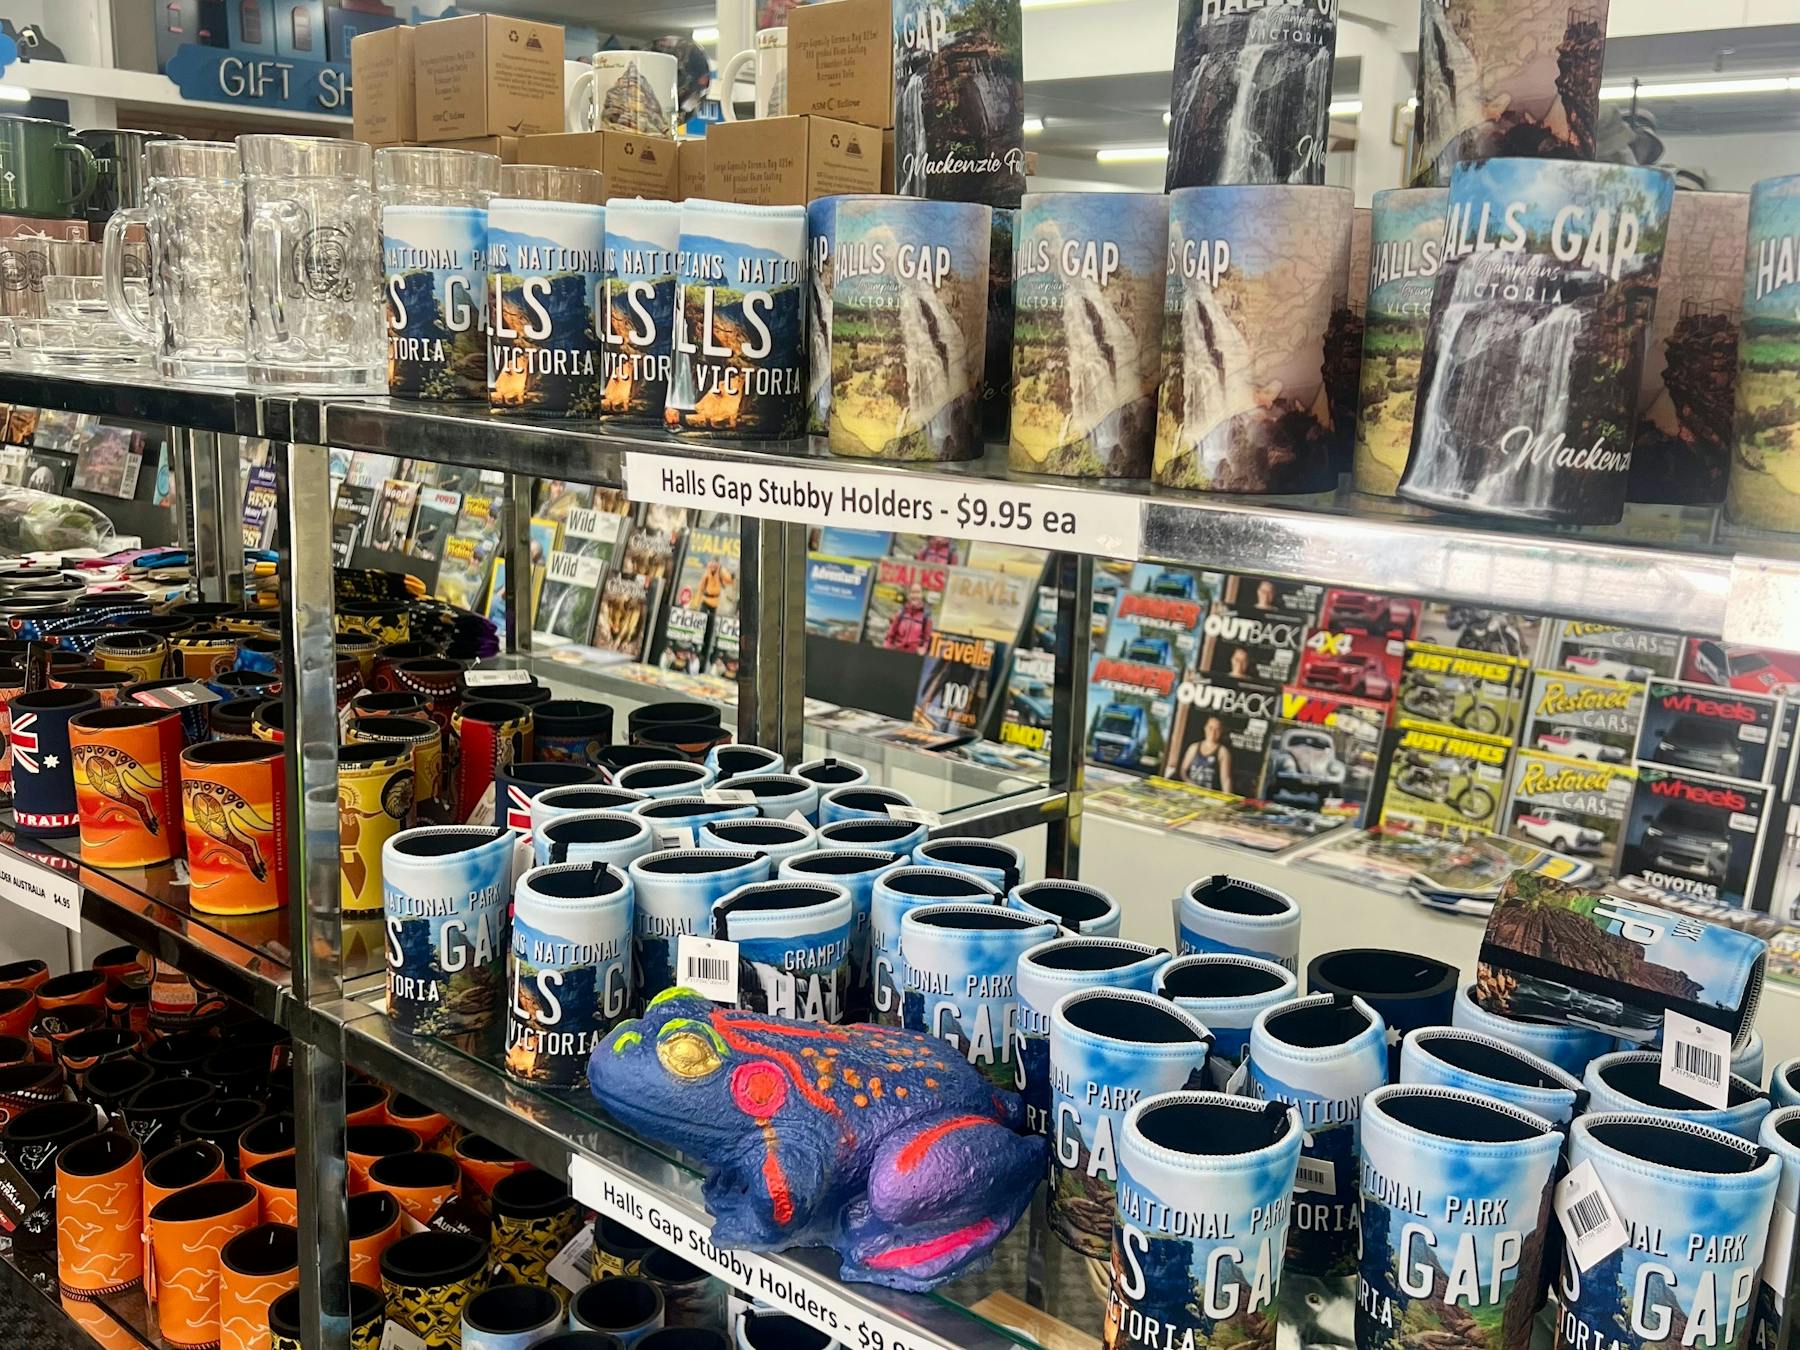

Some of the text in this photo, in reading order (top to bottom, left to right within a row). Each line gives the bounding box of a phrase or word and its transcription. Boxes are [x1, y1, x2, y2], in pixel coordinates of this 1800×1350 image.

[903, 5, 947, 53] GAP
[1249, 29, 1324, 45] VICTORIA
[219, 57, 294, 100] GIFT
[902, 150, 1002, 182] Mackenzie
[518, 245, 602, 272] NATIONA
[1551, 204, 1639, 282] GAP
[834, 242, 950, 289] HALLS GAP
[1062, 240, 1120, 287] GAP
[1183, 239, 1230, 288] GAP
[1370, 240, 1438, 296] HALLS
[1455, 282, 1562, 305] VICTORIA
[674, 283, 774, 359] LLS
[493, 344, 595, 376] VICTORIA
[603, 352, 671, 382] VICTOR
[696, 364, 801, 396] VICTORIA
[661, 468, 706, 498] Halls
[712, 474, 752, 504] Gap
[758, 479, 833, 516] Stubby
[841, 485, 933, 521] Holders
[956, 493, 1033, 531] $9.95
[1043, 507, 1077, 535] ea
[569, 510, 597, 532] Wild
[551, 553, 579, 578] Wild
[811, 564, 862, 586] Adventure
[1204, 614, 1300, 649] OUTBACK
[1611, 632, 1658, 653] CARS
[929, 632, 995, 667] Traveller
[1406, 653, 1452, 673] JUST
[943, 682, 969, 709] 100
[1177, 681, 1274, 718] OUTBACK
[1536, 683, 1636, 716] Restored
[1662, 694, 1757, 723] wheels
[1583, 711, 1630, 732] CARS
[1401, 731, 1447, 751] JUST
[1516, 764, 1616, 795] Restored
[1651, 780, 1746, 811] wheels
[14, 808, 80, 827] TRALIA
[1561, 792, 1608, 816] CARS
[13, 876, 46, 898] AUSTRALIA
[54, 893, 71, 909] $4.95
[388, 883, 501, 917] ATIONAL PARK
[1641, 869, 1718, 899] TOYOTA'S
[638, 913, 697, 937] TIONAL
[534, 938, 621, 967] NATIONAL
[389, 972, 439, 1002] TORIA
[966, 975, 1013, 999] PARK
[509, 1017, 599, 1056] VICTORIA
[1087, 1081, 1141, 1112] PARK
[1057, 1102, 1118, 1180] GA
[1362, 1160, 1509, 1226] TIONAL PARK
[1121, 1182, 1235, 1240] NATIONAL
[1289, 1201, 1359, 1233] TORIA
[603, 1181, 644, 1221] Halls
[648, 1207, 683, 1243] Gap
[688, 1230, 753, 1286] Stubby
[760, 1268, 838, 1329] Holders
[1687, 1233, 1748, 1263] PARK
[1399, 1222, 1524, 1307] GAP
[1631, 1262, 1755, 1348] GAP
